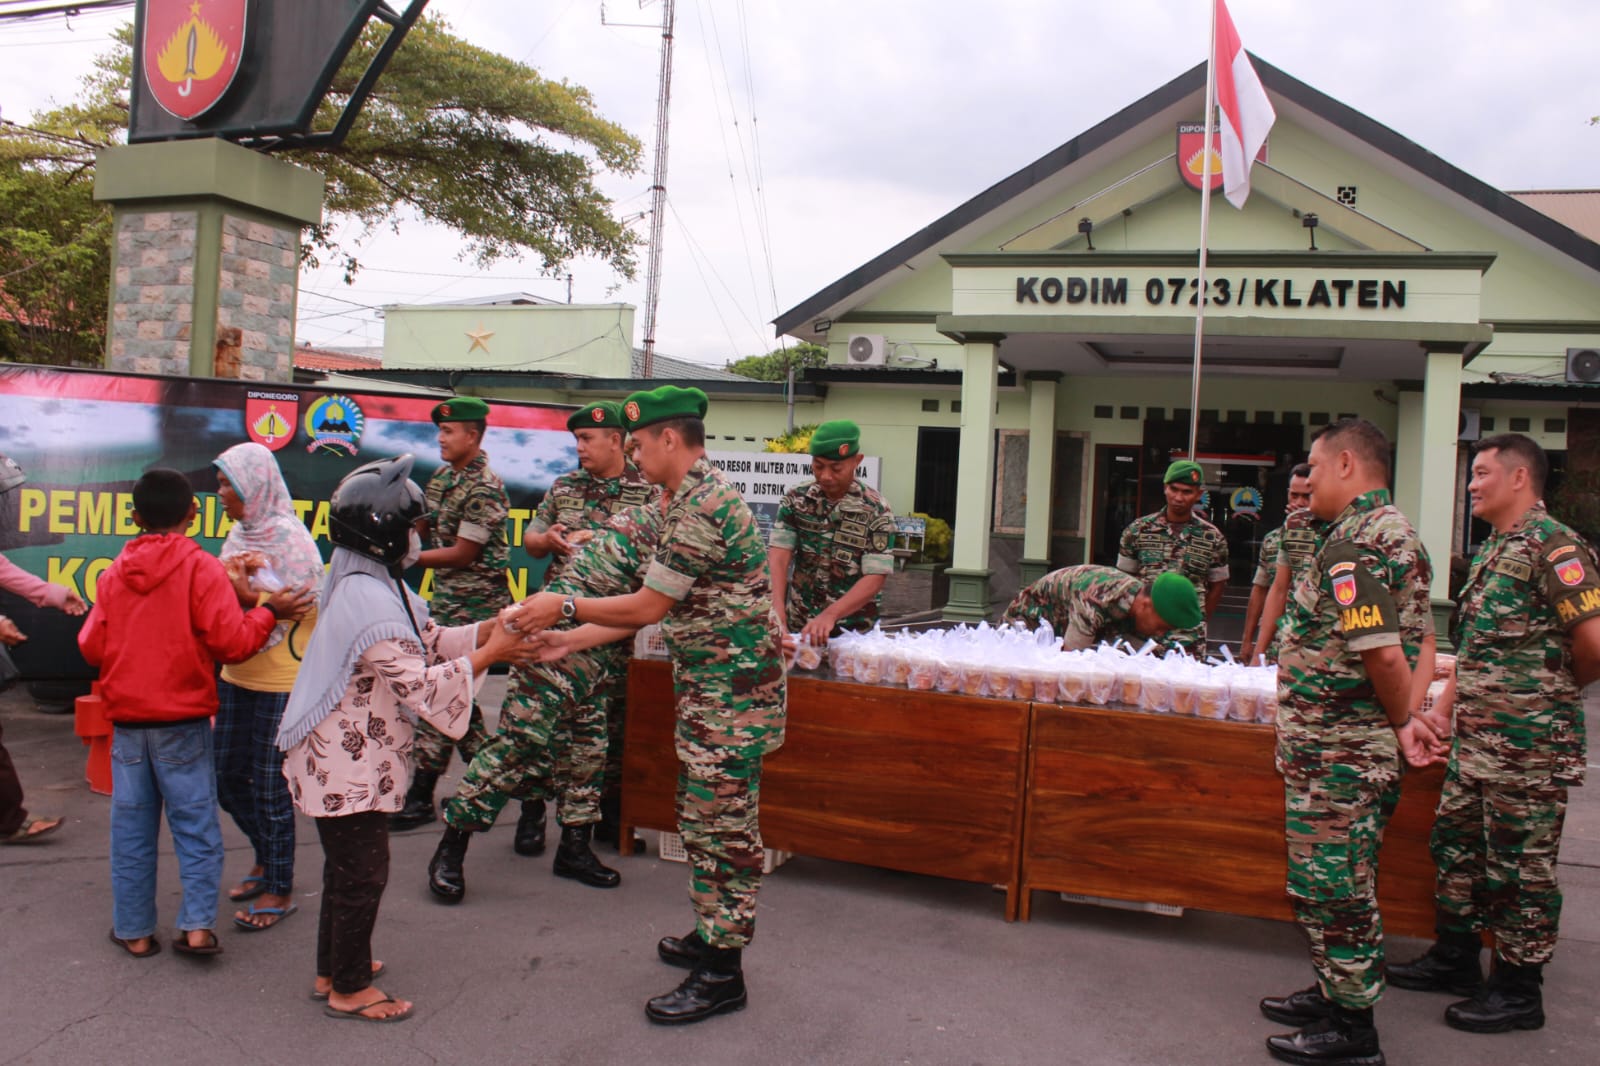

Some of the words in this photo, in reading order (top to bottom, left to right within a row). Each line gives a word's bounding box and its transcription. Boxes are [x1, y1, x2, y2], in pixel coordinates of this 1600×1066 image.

[1016, 277, 1128, 304] KODIM
[1145, 278, 1406, 308] 0723/KLATEN
[248, 391, 299, 401] DIPONEGORO
[727, 461, 751, 473] RESOR
[754, 462, 785, 475] MILITER
[753, 483, 785, 496] DISTRIK
